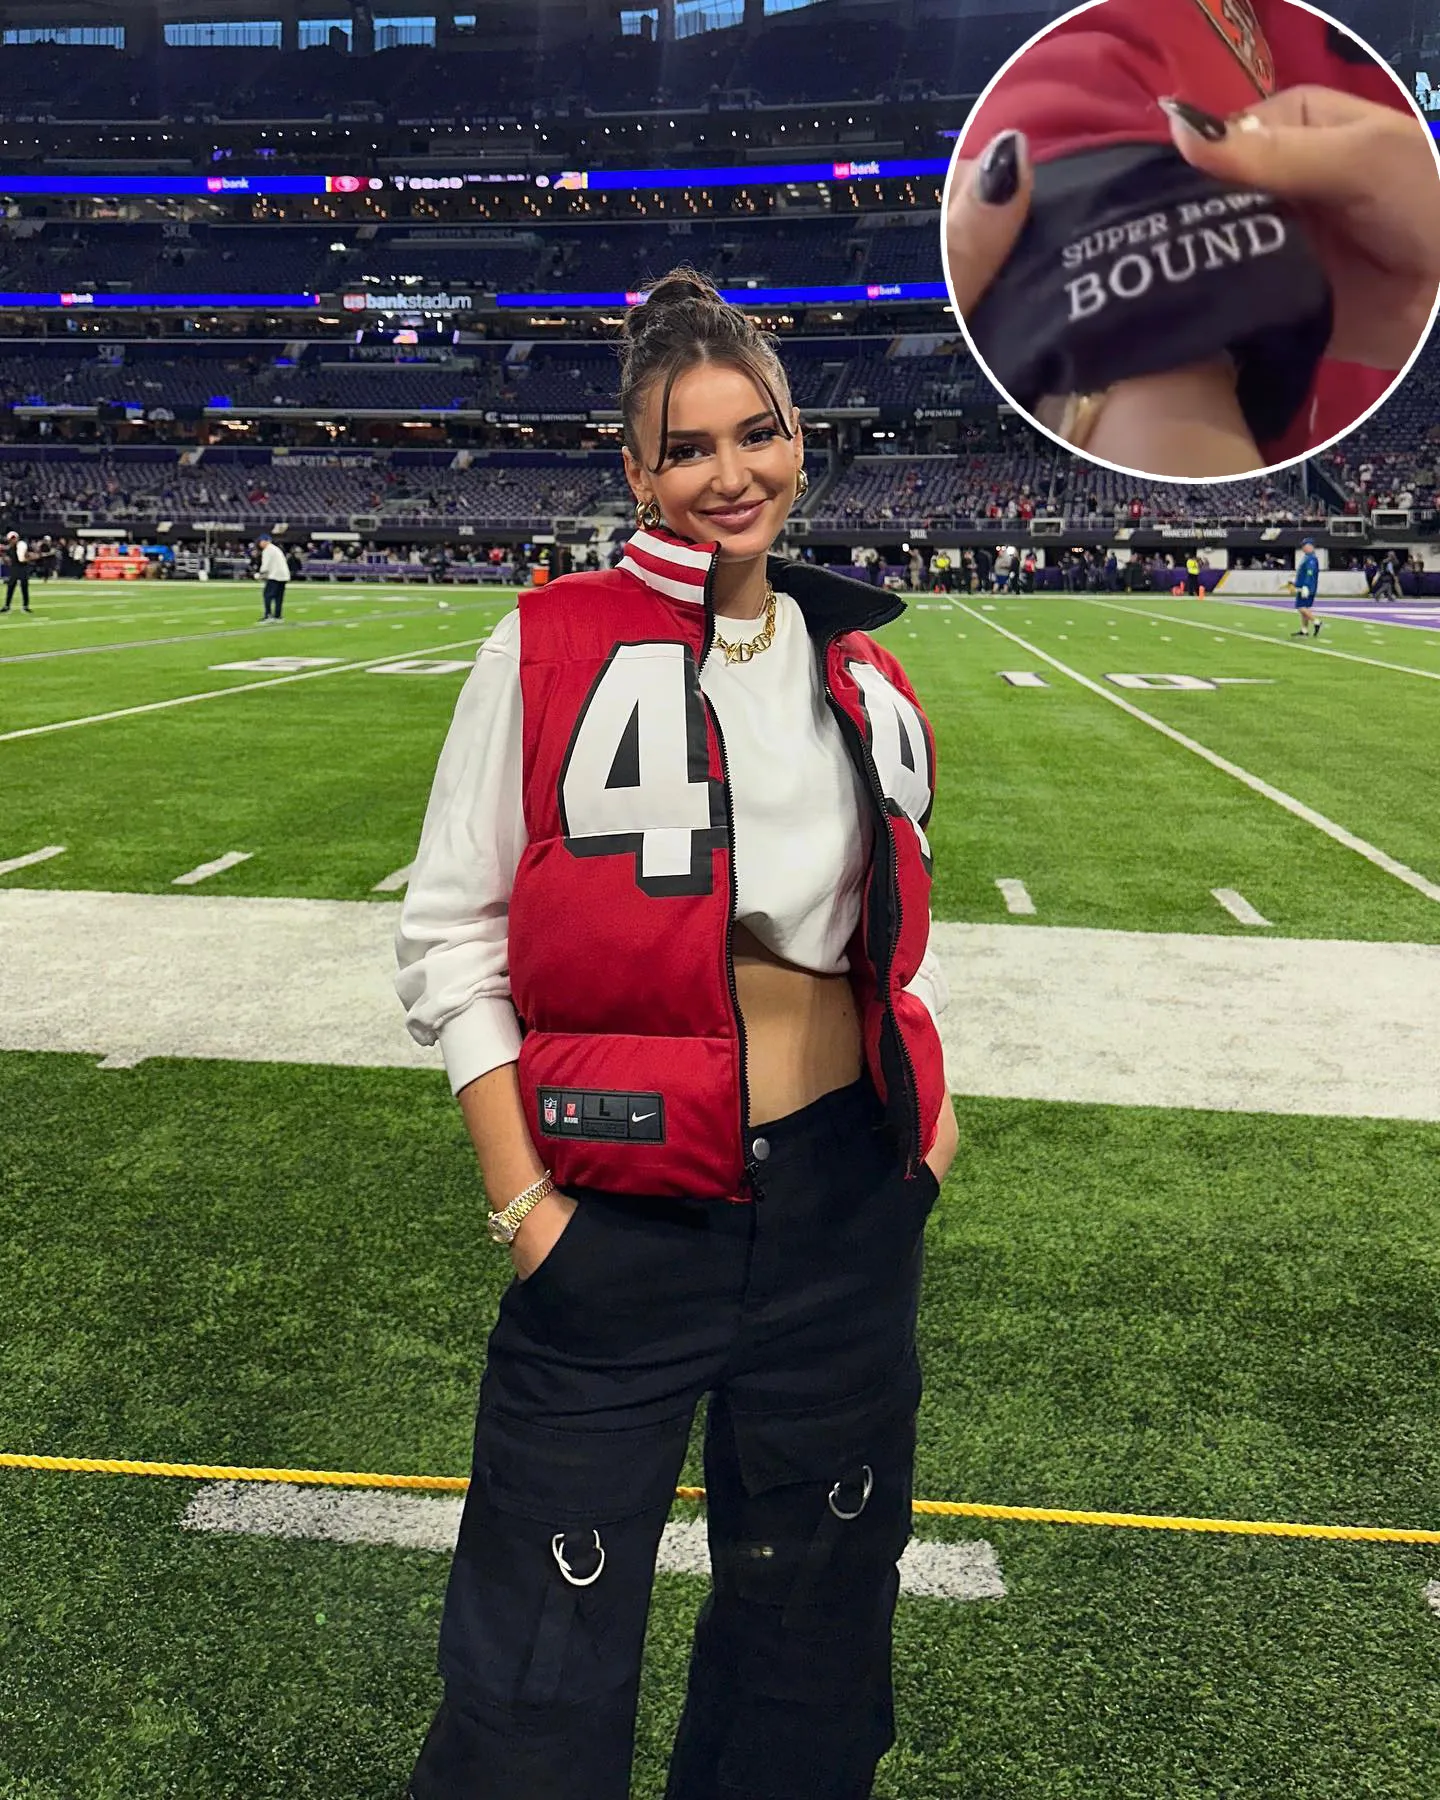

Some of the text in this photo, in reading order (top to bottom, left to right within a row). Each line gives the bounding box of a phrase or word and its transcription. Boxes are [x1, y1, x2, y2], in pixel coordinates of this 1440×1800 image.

[1062, 213, 1168, 268] SUPER
[1064, 214, 1286, 322] BOUND
[560, 641, 724, 891] 4
[599, 1097, 611, 1117] L
